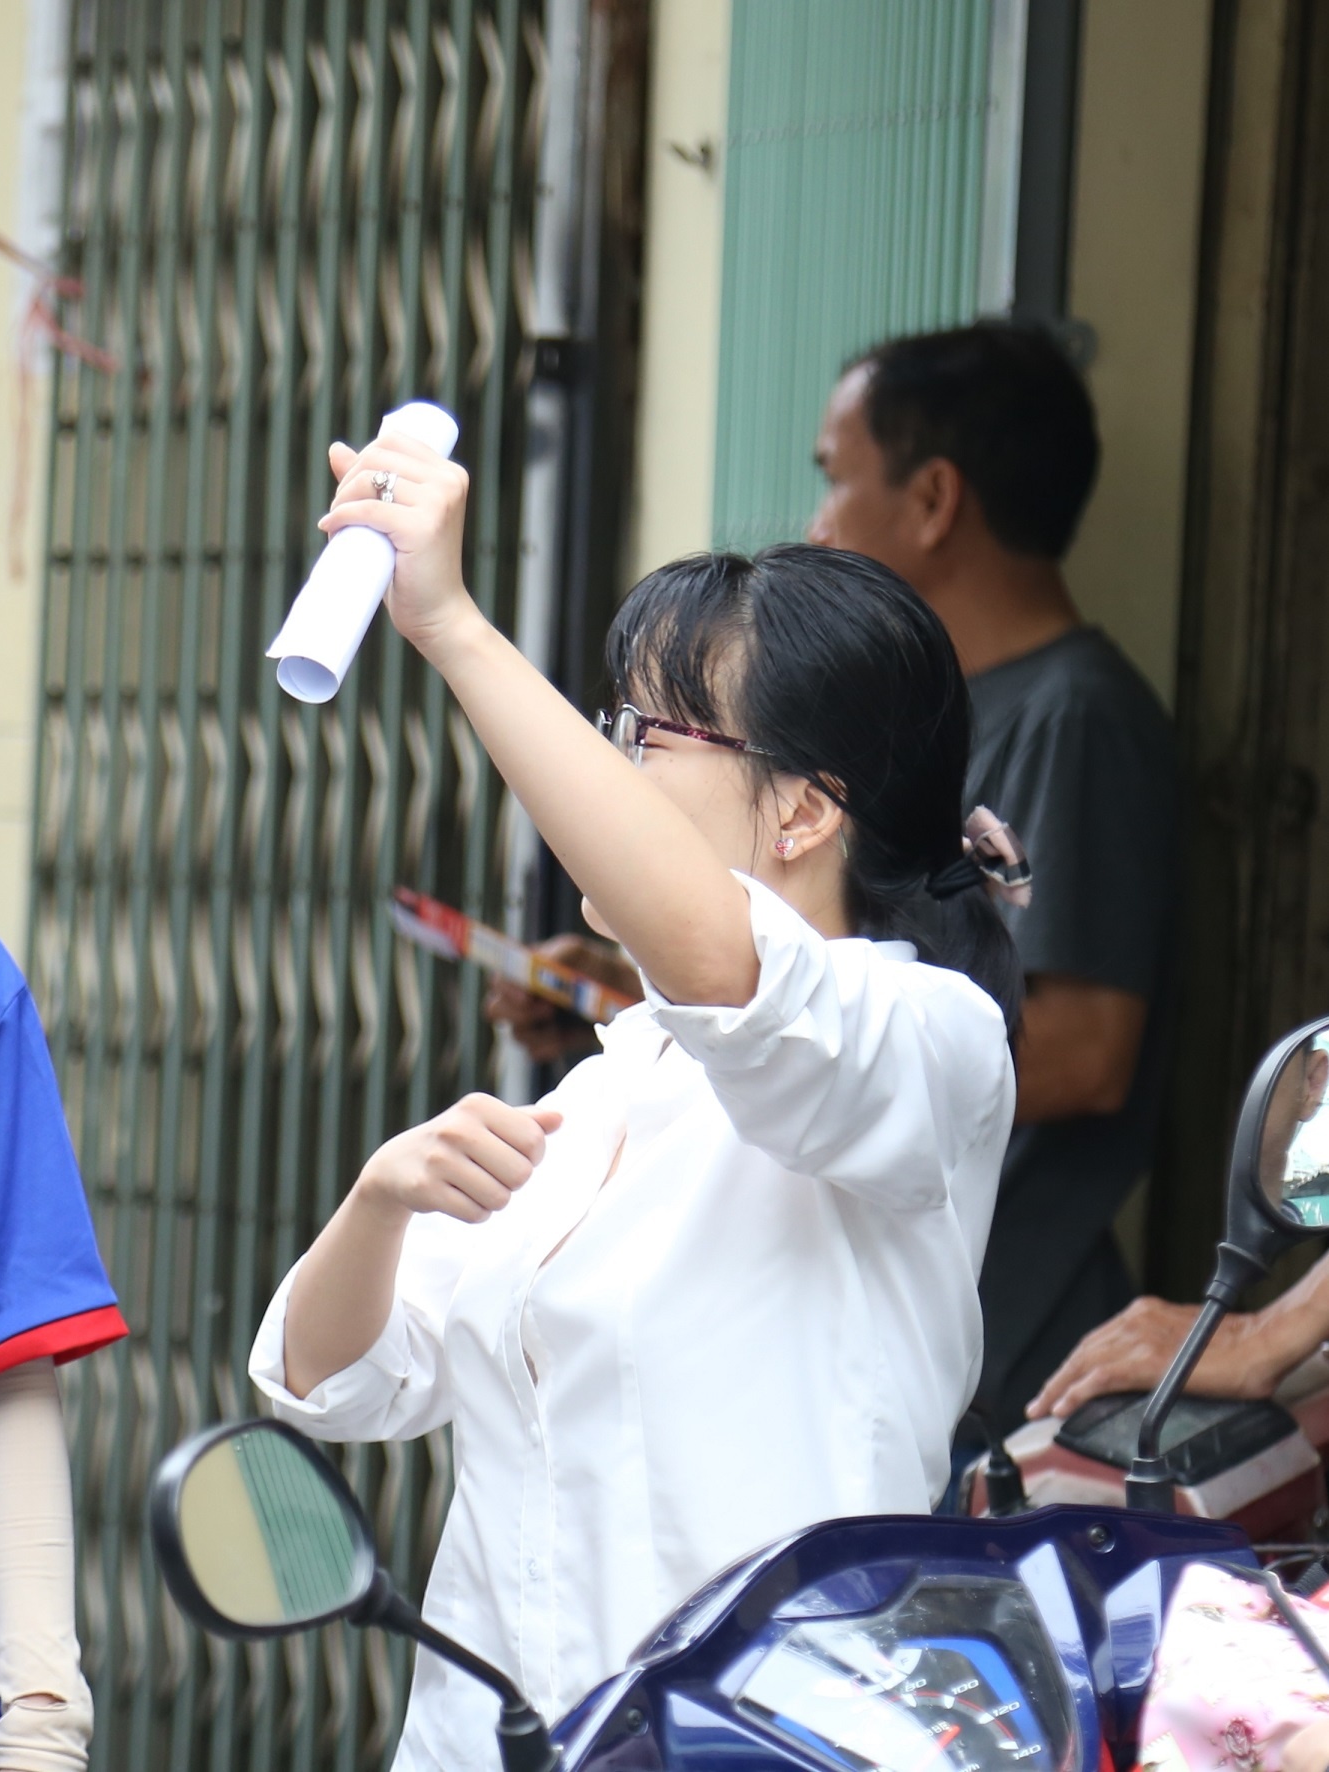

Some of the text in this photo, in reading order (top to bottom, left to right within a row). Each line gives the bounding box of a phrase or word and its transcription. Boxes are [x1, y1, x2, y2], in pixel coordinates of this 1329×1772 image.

[951, 1679, 979, 1695] 100
[992, 1701, 1020, 1717] 120
[1012, 1744, 1042, 1760] 140
